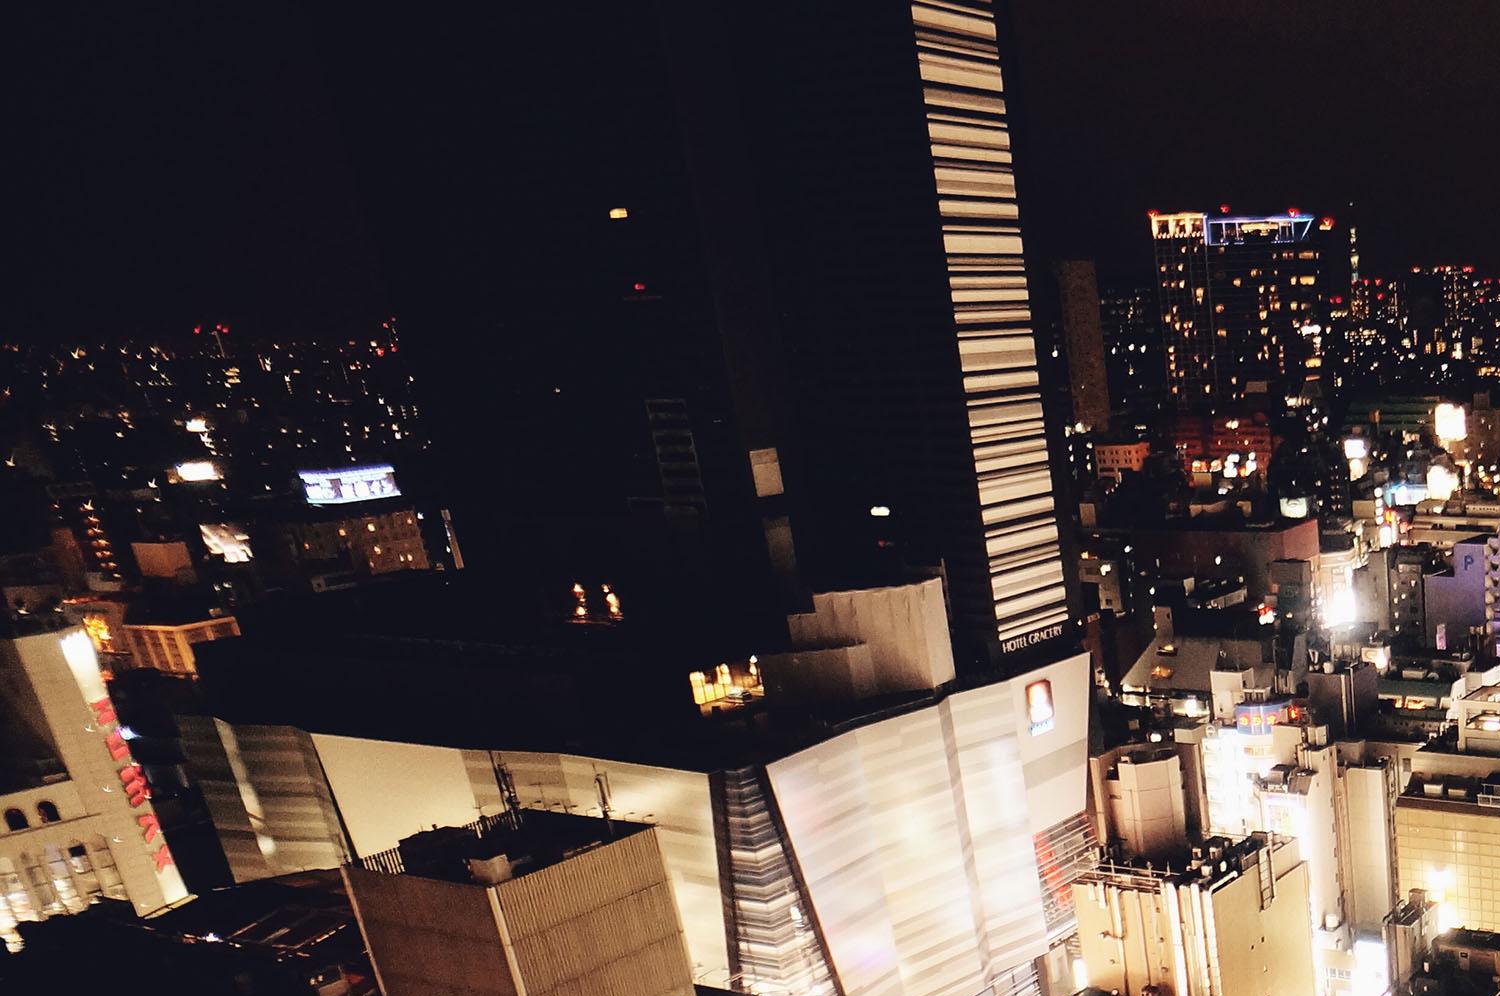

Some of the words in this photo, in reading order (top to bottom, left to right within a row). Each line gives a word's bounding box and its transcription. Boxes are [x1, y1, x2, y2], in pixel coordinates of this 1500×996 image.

[1463, 555, 1474, 571] P
[1002, 637, 1029, 653] HOTEL
[1028, 625, 1063, 644] GRACERY
